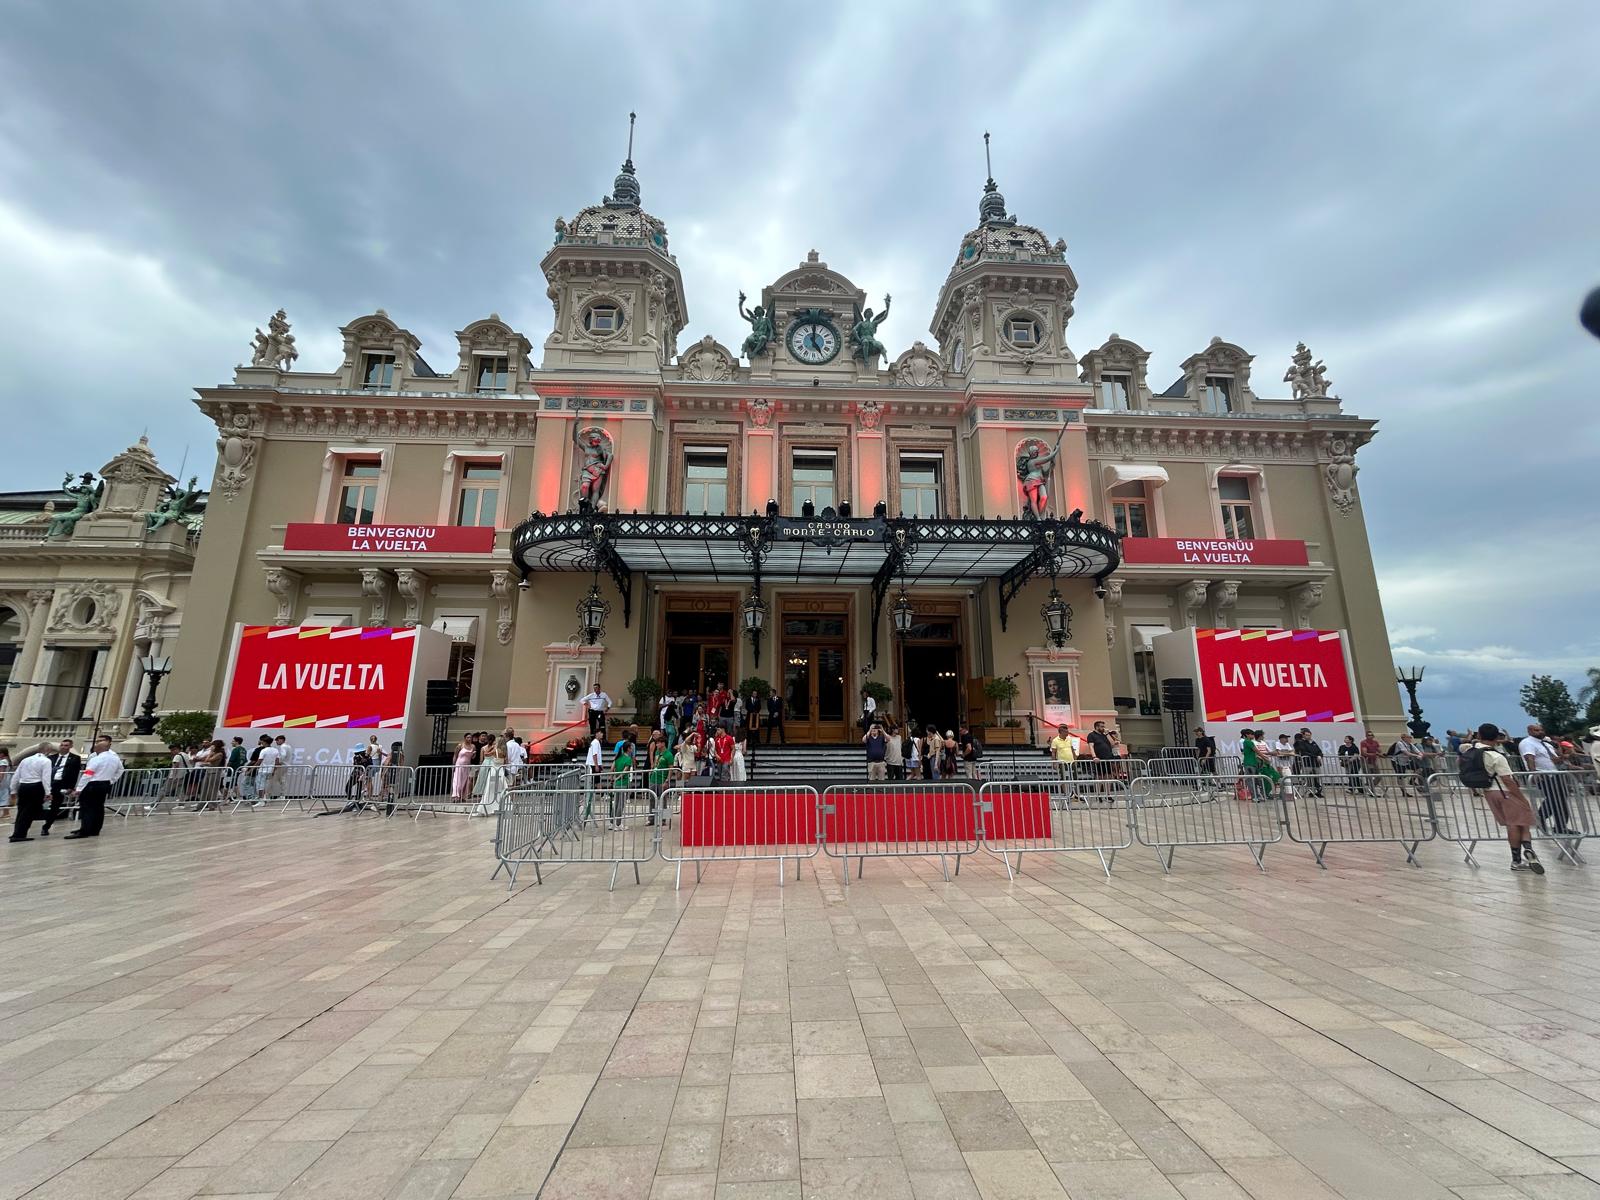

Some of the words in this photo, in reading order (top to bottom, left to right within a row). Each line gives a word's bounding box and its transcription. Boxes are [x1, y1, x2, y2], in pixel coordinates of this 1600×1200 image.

[807, 522, 851, 530] CASINO
[347, 526, 436, 539] BENVEGNÜU
[783, 528, 875, 537] MONTE-CARLO
[351, 539, 371, 550] LA
[375, 540, 428, 551] VUELTA
[1175, 540, 1254, 552] BENVEGNÜU
[1183, 552, 1201, 562] LA
[1203, 553, 1251, 563] VUELTA
[257, 663, 288, 690] LA
[295, 663, 385, 690] VUELTA
[1218, 662, 1247, 687] LA
[1246, 663, 1329, 688] VUELTA
